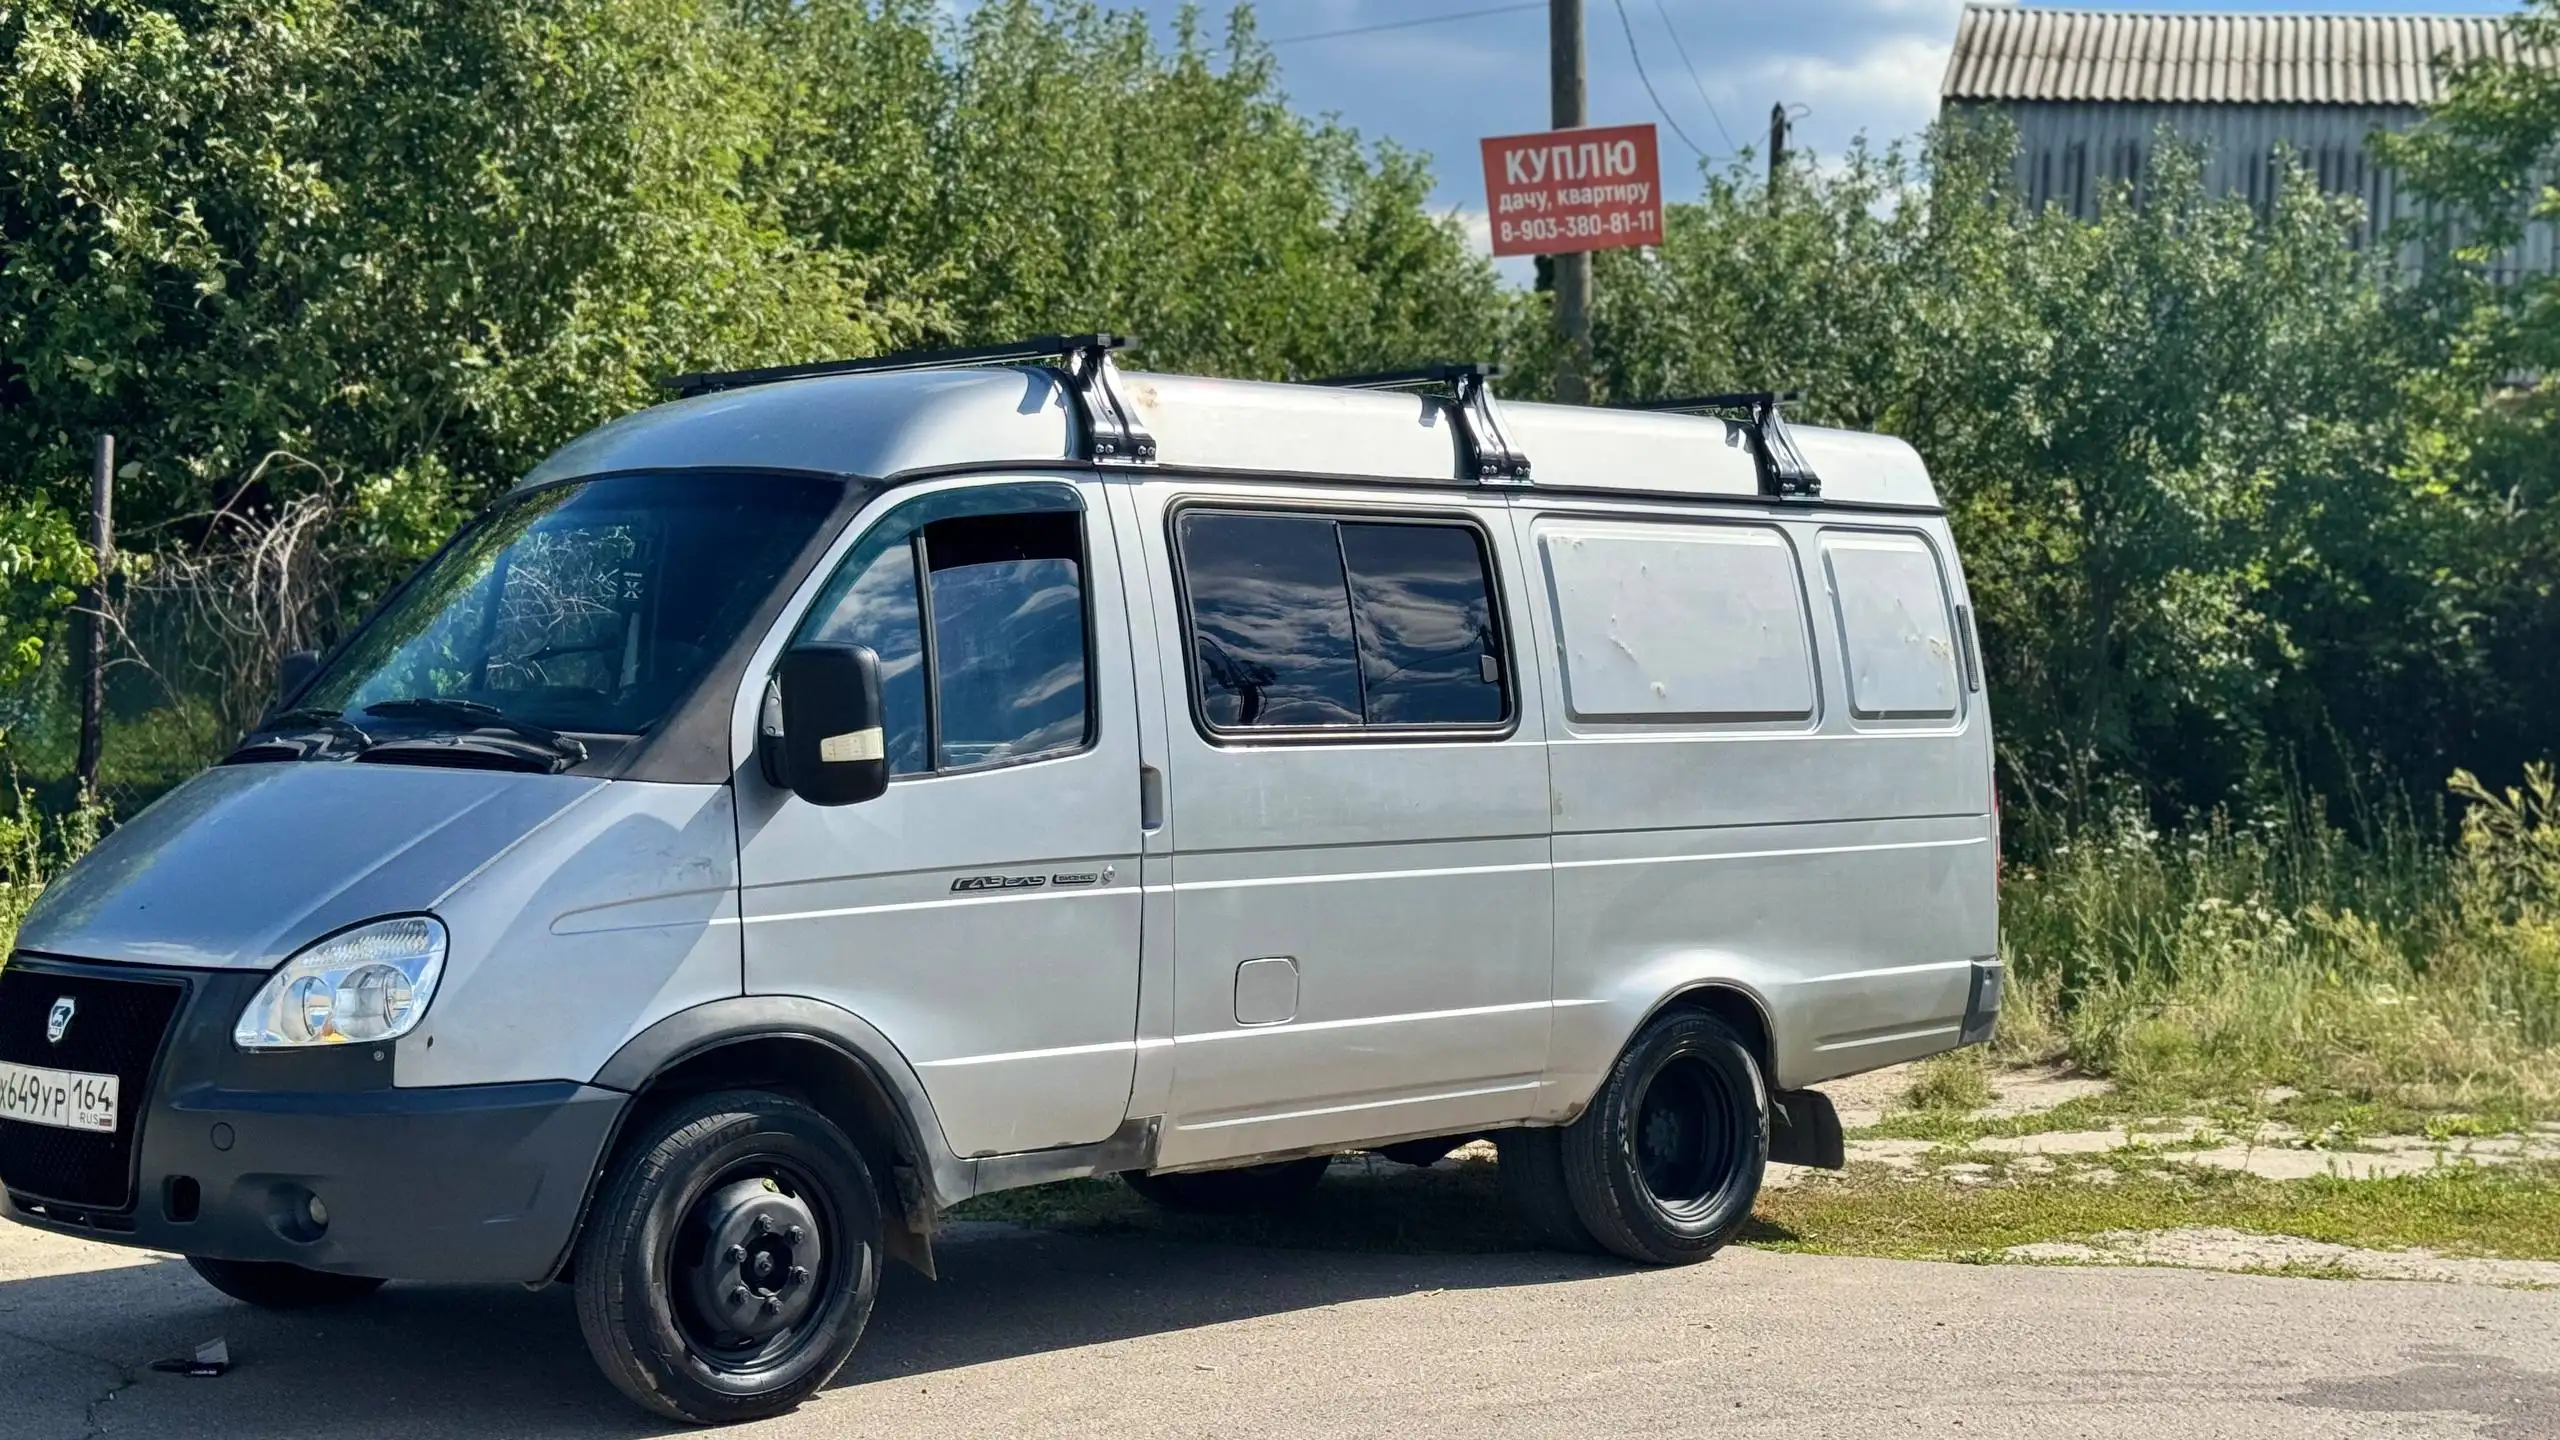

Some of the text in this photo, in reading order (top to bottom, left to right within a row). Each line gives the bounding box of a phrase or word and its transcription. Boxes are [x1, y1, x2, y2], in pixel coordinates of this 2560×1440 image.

[1505, 140, 1637, 185] КУПЛЮ
[1499, 182, 1650, 214] дачу, квартиру
[1500, 210, 1655, 243] 8-903-380-81-11
[73, 1079, 112, 1112] 164
[79, 1112, 99, 1126] RUS
